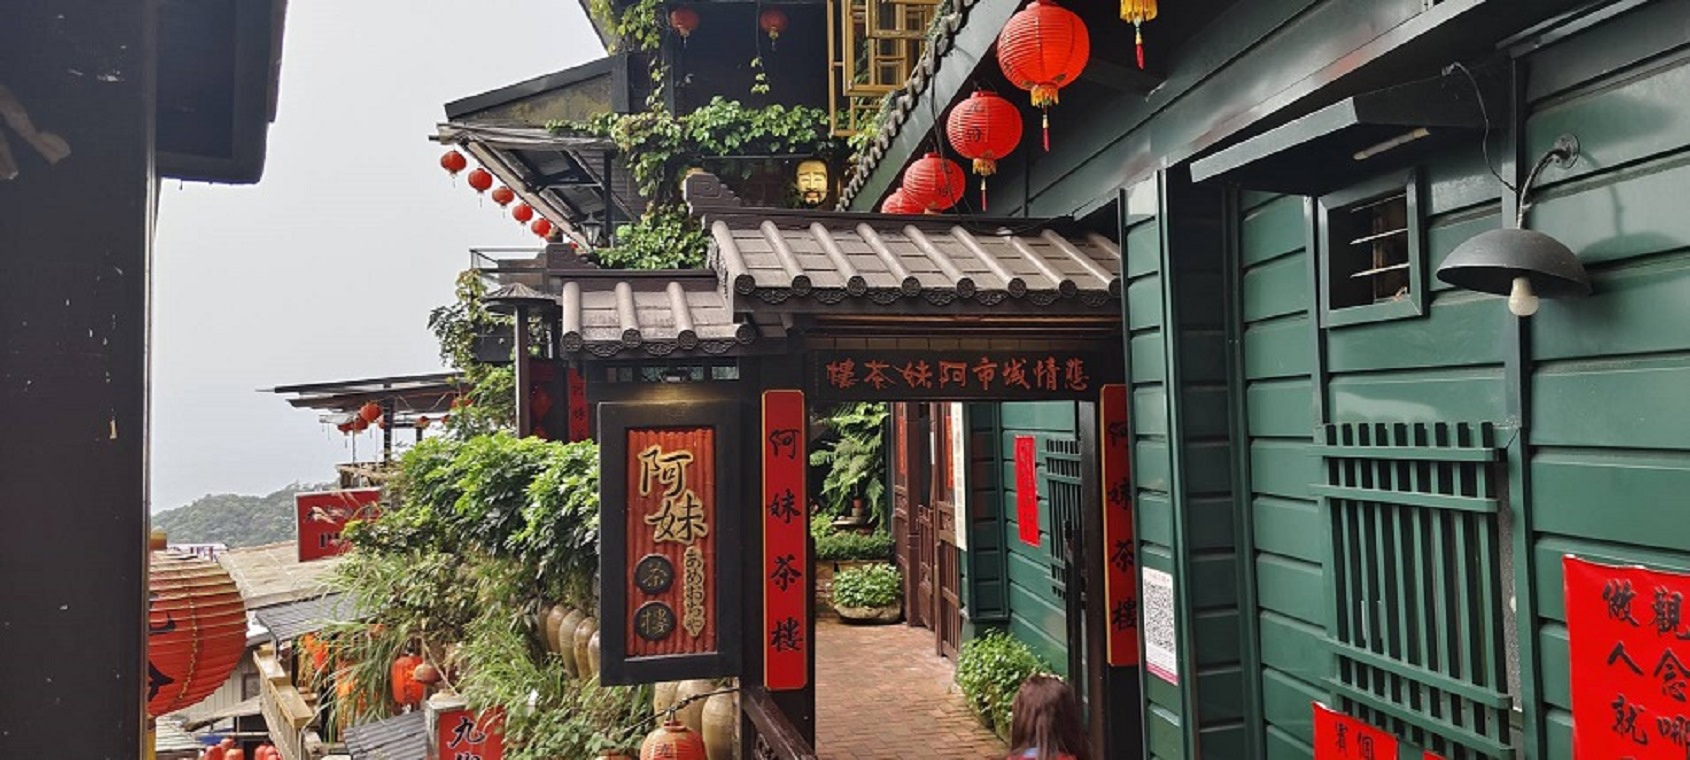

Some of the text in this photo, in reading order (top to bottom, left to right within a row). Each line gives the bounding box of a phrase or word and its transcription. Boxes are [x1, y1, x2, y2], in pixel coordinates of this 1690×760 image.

[638, 444, 709, 545] 阿妹
[765, 429, 804, 652] 阿妹茶樓
[447, 716, 487, 760] 九
